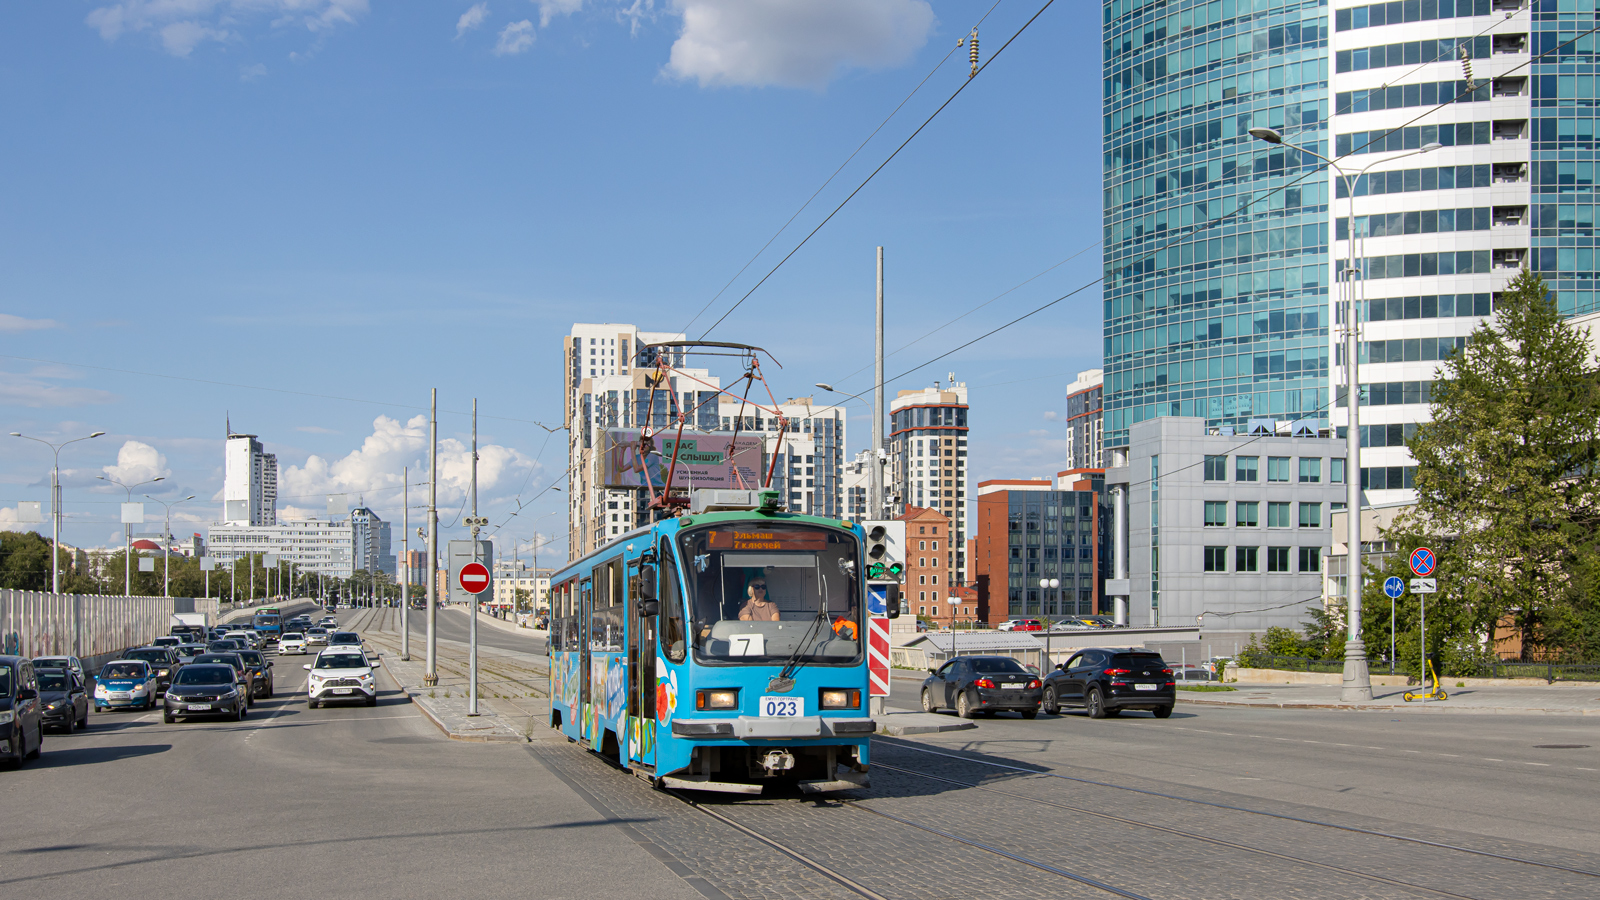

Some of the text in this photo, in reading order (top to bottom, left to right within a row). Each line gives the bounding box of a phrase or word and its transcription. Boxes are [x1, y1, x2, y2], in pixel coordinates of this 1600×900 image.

[680, 454, 720, 462] СЛЫШУ!
[708, 530, 773, 544] 7 Эльмаш
[734, 540, 781, 549] 7 ключей
[737, 638, 750, 656] 7
[766, 701, 797, 716] 023
